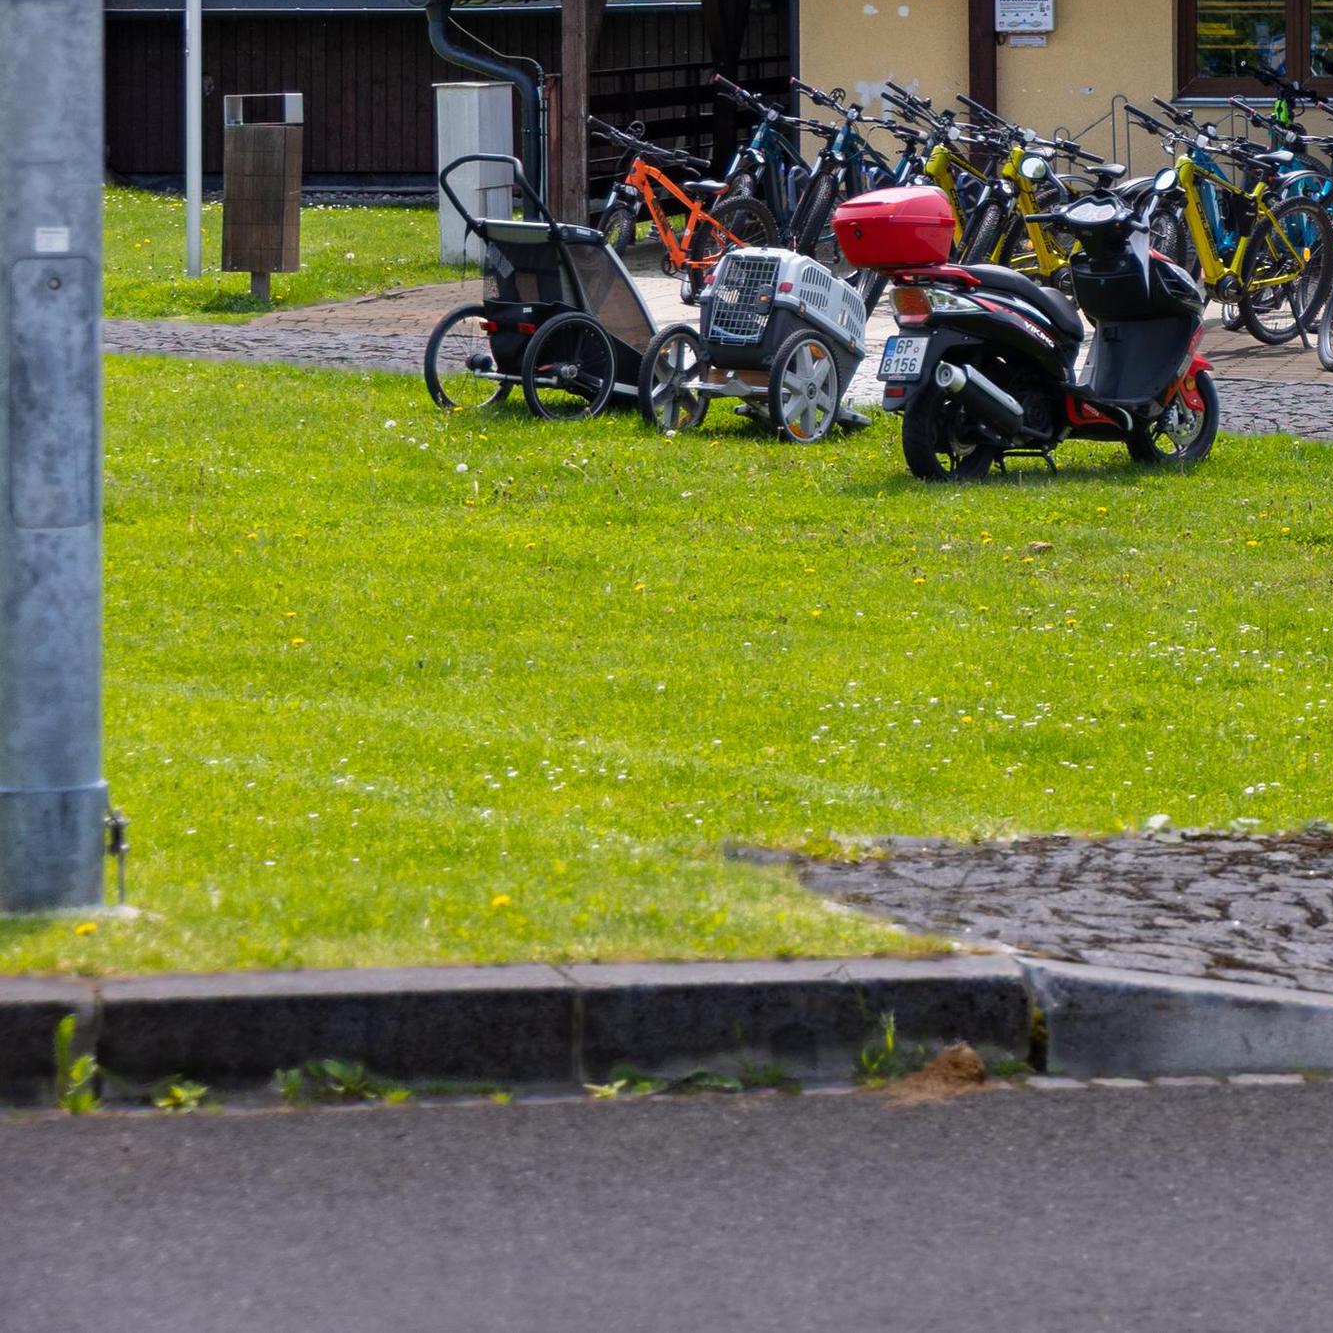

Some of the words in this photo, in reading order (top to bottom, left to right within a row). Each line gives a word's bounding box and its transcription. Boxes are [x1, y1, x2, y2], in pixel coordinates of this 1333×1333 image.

[1024, 320, 1055, 348] VIKING
[896, 339, 913, 355] 6P
[883, 357, 918, 373] 8156
